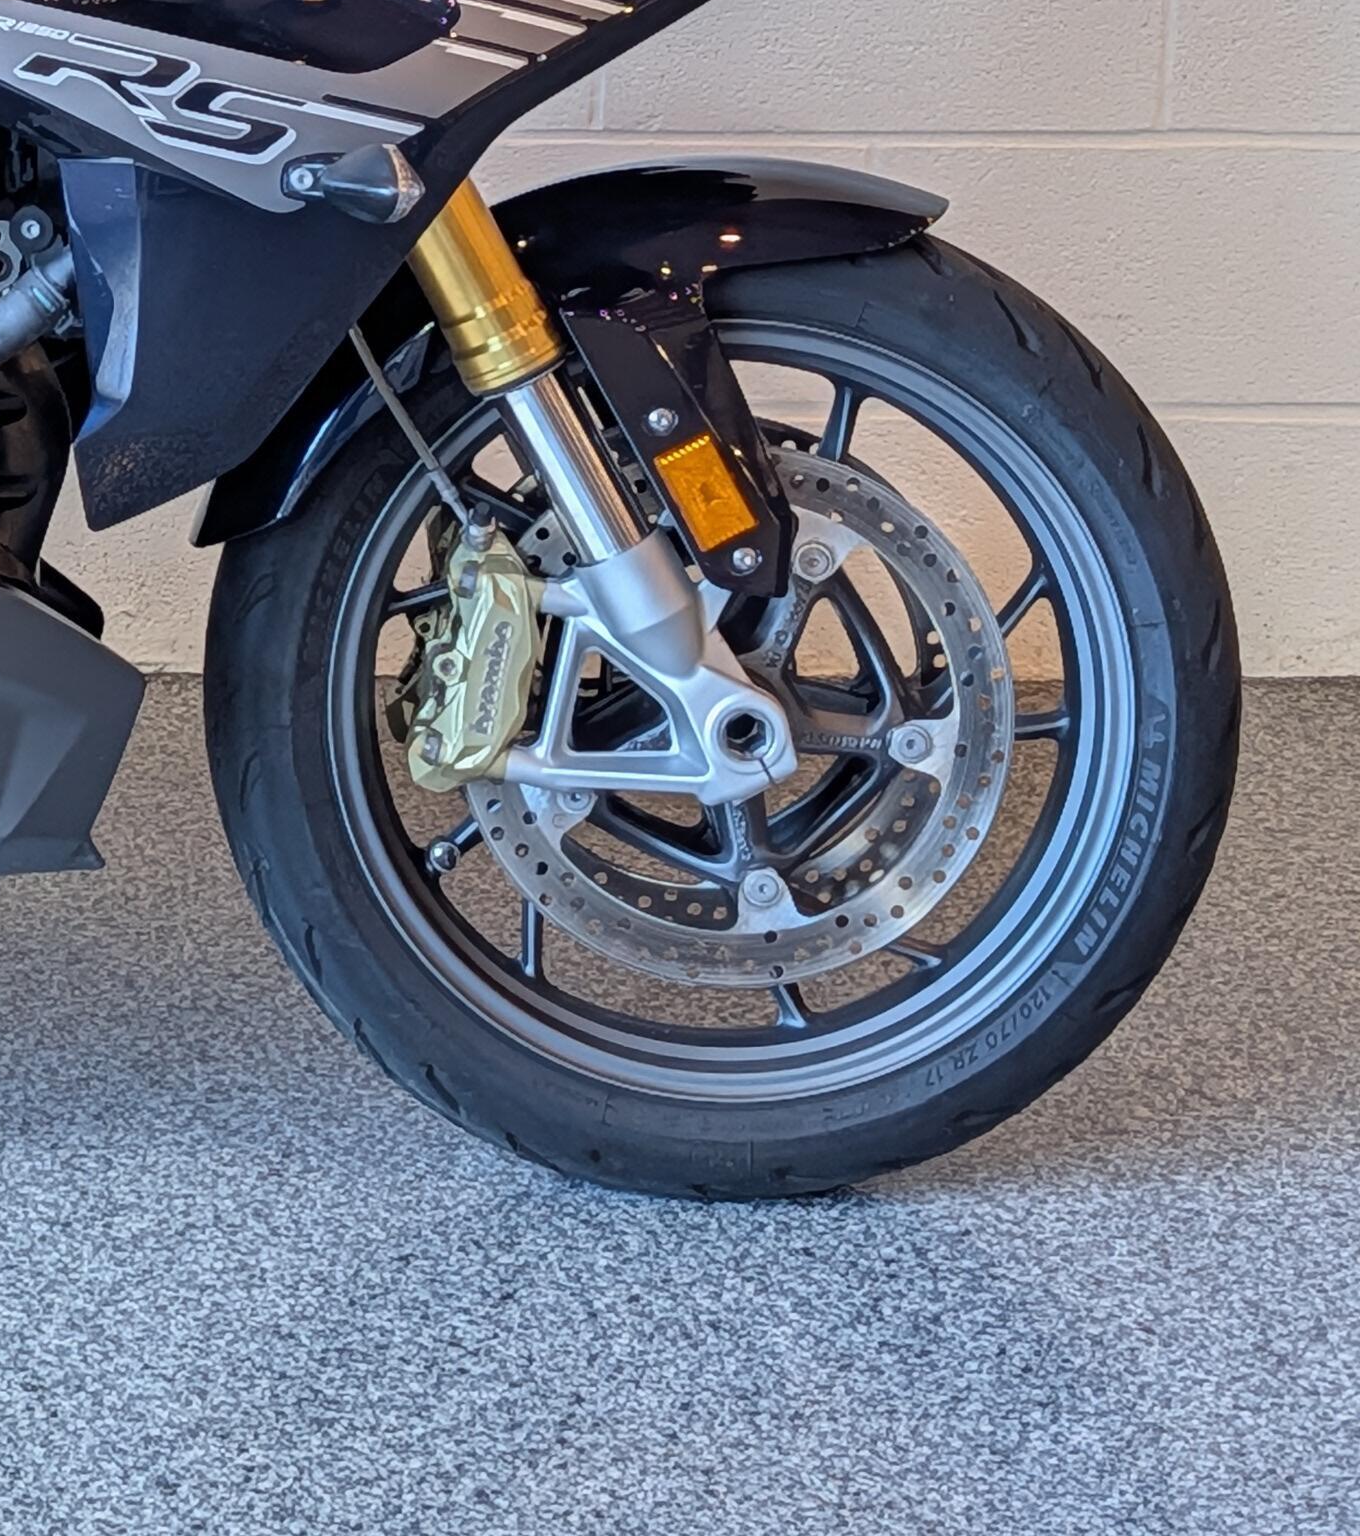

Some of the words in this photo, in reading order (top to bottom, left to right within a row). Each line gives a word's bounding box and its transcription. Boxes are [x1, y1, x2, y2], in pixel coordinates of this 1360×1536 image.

[13, 33, 424, 165] RS
[468, 621, 512, 735] brembo
[1074, 762, 1162, 956] MICHELIN
[952, 1048, 978, 1070] ZR
[985, 989, 1053, 1051] 120/70
[924, 1064, 945, 1087] 17
